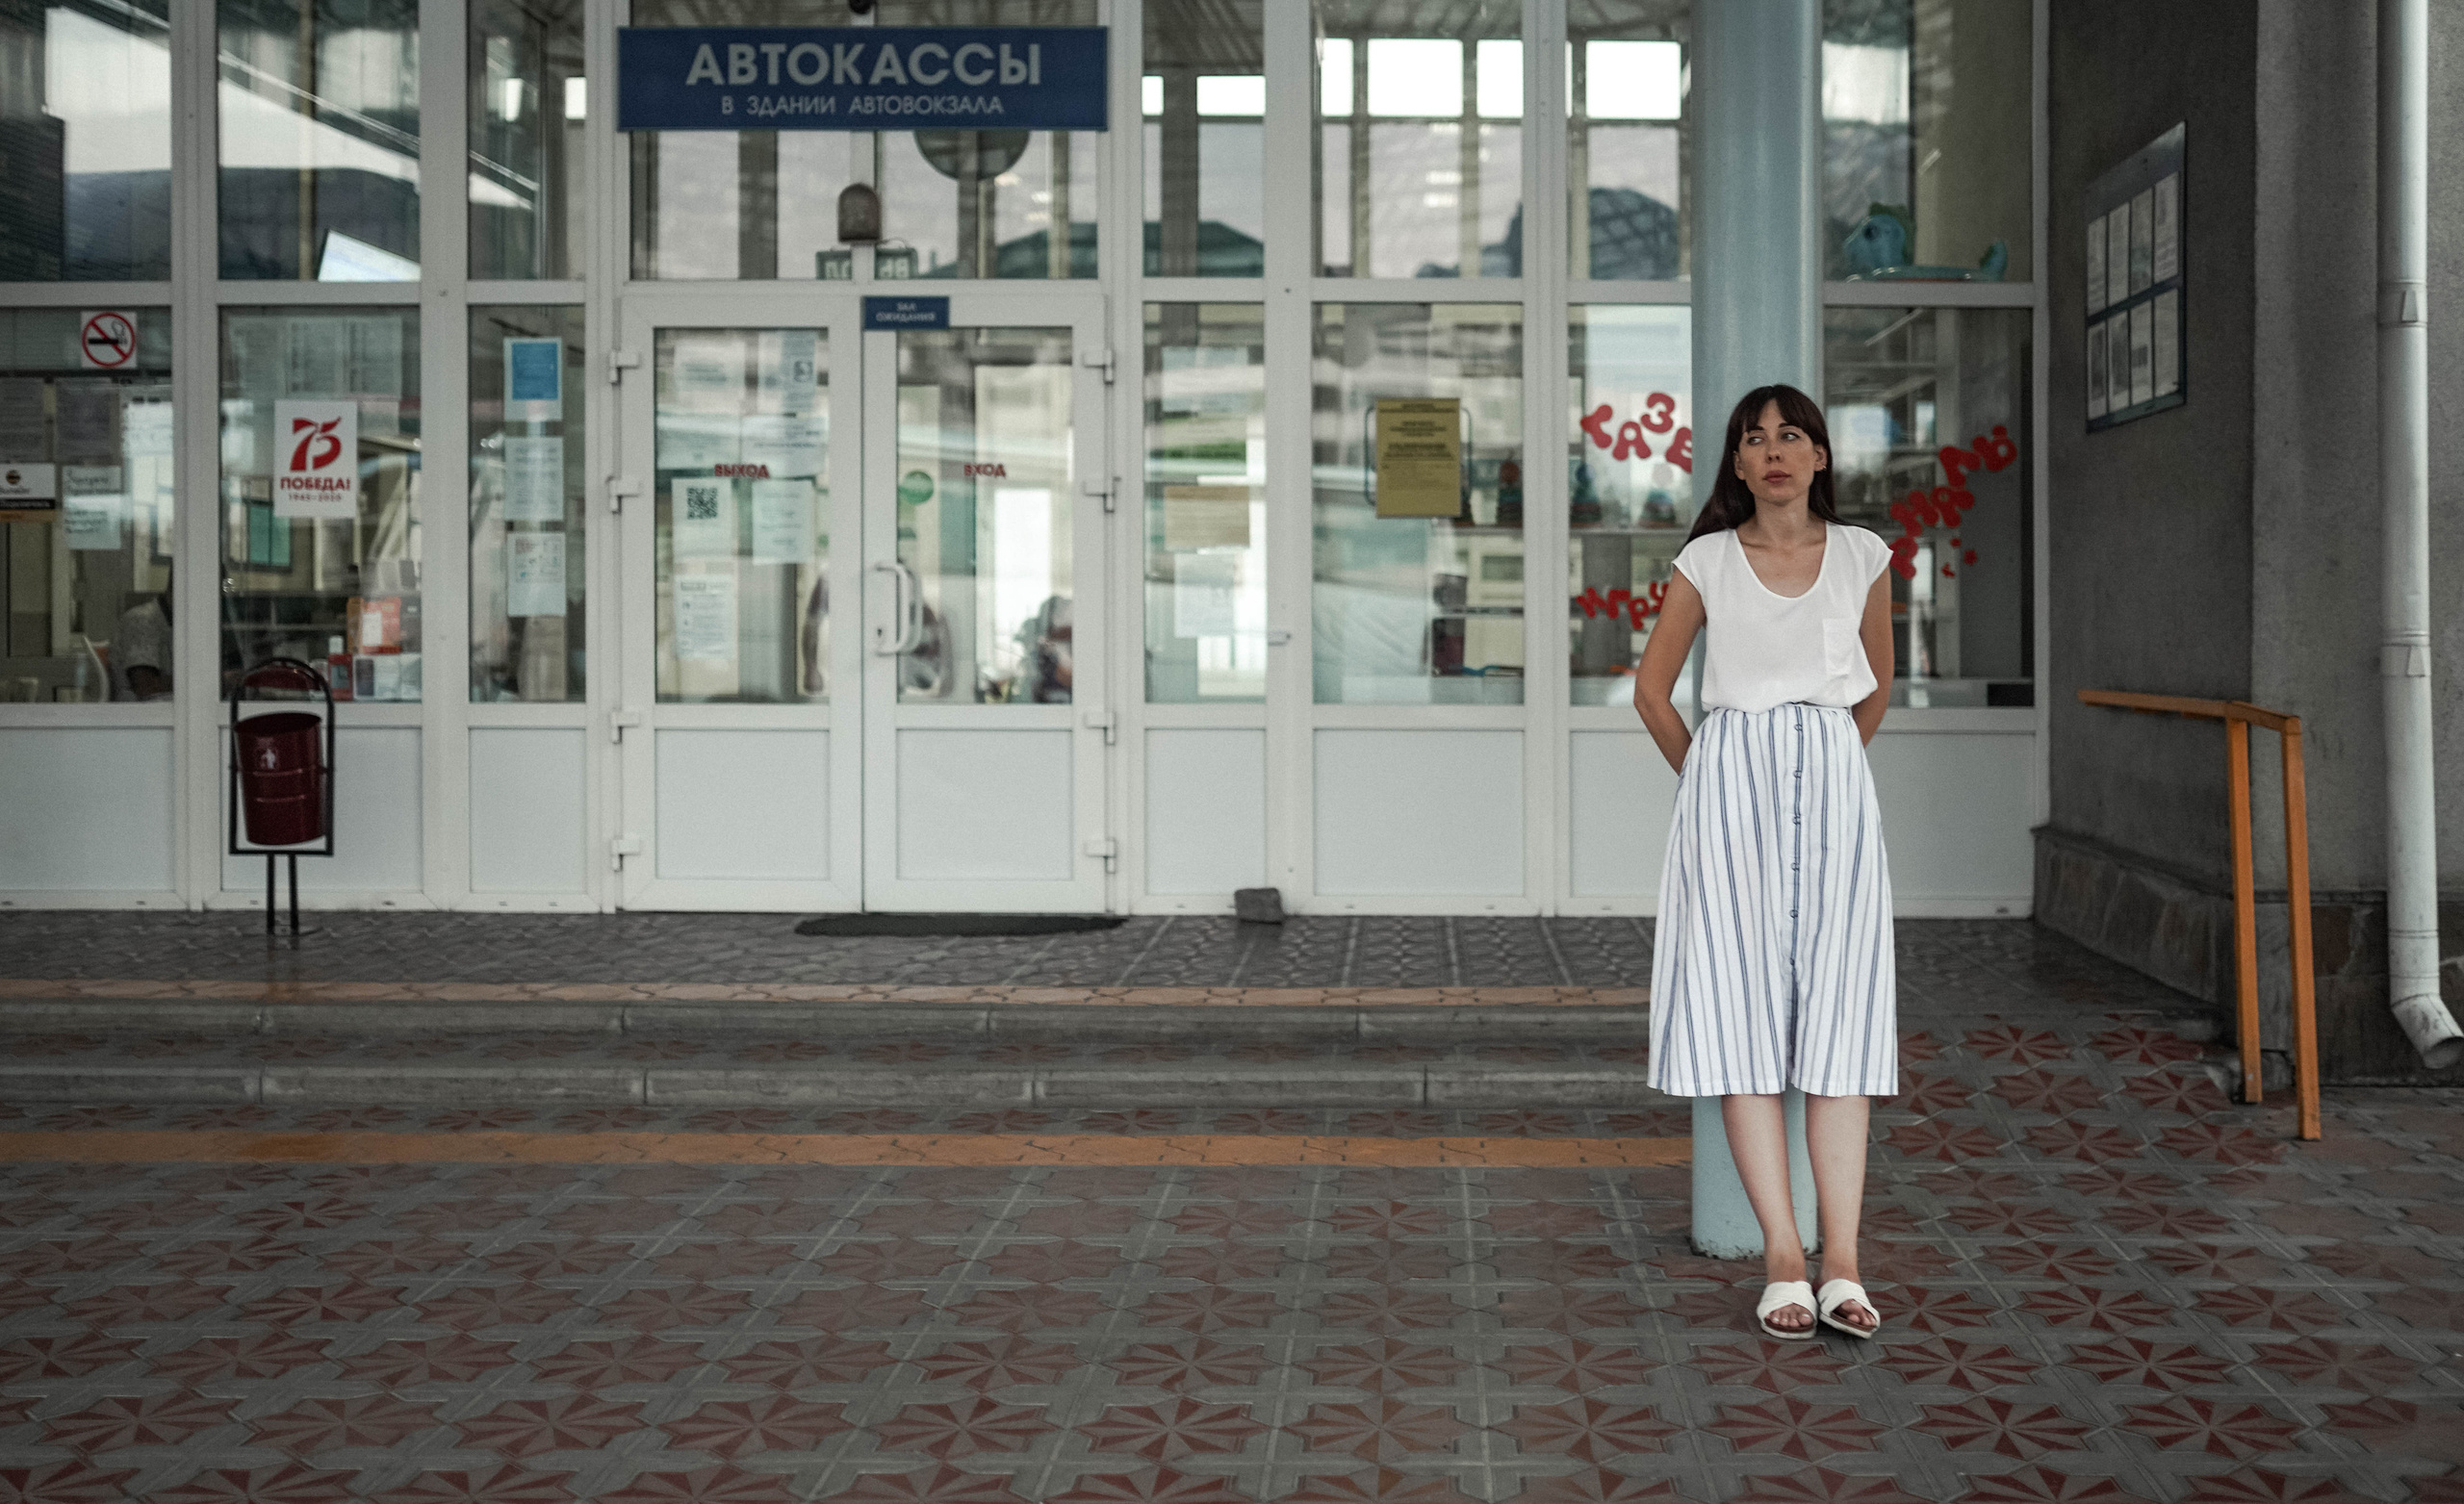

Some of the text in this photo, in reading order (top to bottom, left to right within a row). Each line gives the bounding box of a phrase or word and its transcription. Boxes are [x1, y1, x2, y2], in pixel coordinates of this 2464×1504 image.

[685, 42, 1041, 86] АВТОКАССЫ
[721, 95, 1004, 116] В ЗДАНИИ АВТОВОКЗАЛА
[1579, 392, 1692, 473] ГАЗЕ
[290, 416, 342, 472] 75
[714, 464, 770, 478] ВЫХОД
[963, 464, 1006, 477] ВХОД
[280, 476, 350, 492] ПОБЕДА!
